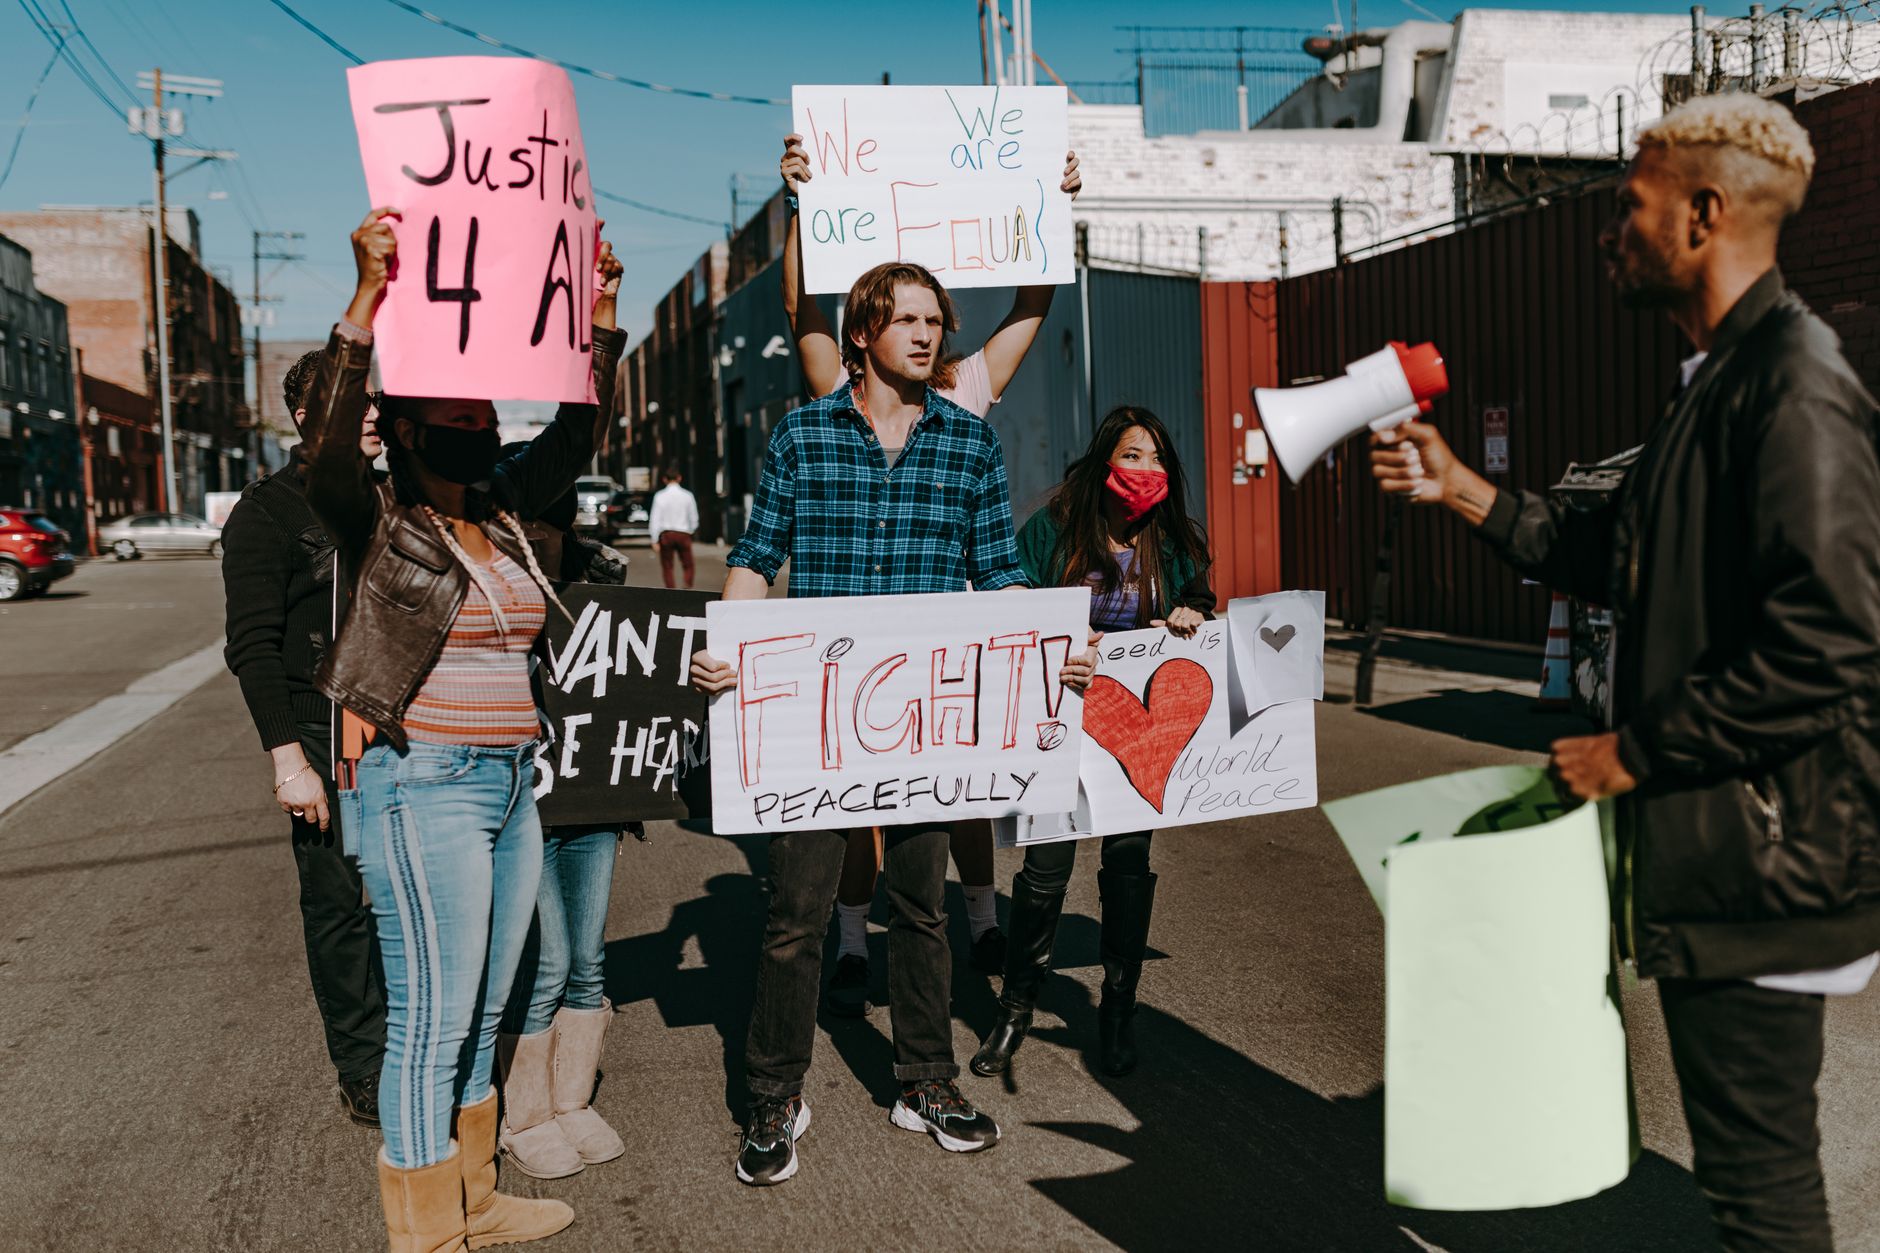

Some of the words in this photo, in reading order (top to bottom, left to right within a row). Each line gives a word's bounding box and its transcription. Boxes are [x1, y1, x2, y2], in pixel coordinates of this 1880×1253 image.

[807, 97, 879, 177] We
[944, 86, 1024, 140] We
[950, 138, 1023, 171] are
[811, 207, 877, 245] are
[426, 215, 482, 355] 4
[1097, 633, 1167, 665] eed
[1199, 630, 1222, 650] is
[1172, 732, 1289, 783] World
[753, 769, 1040, 827] PEACEFULLY
[1177, 777, 1310, 818] Peace
